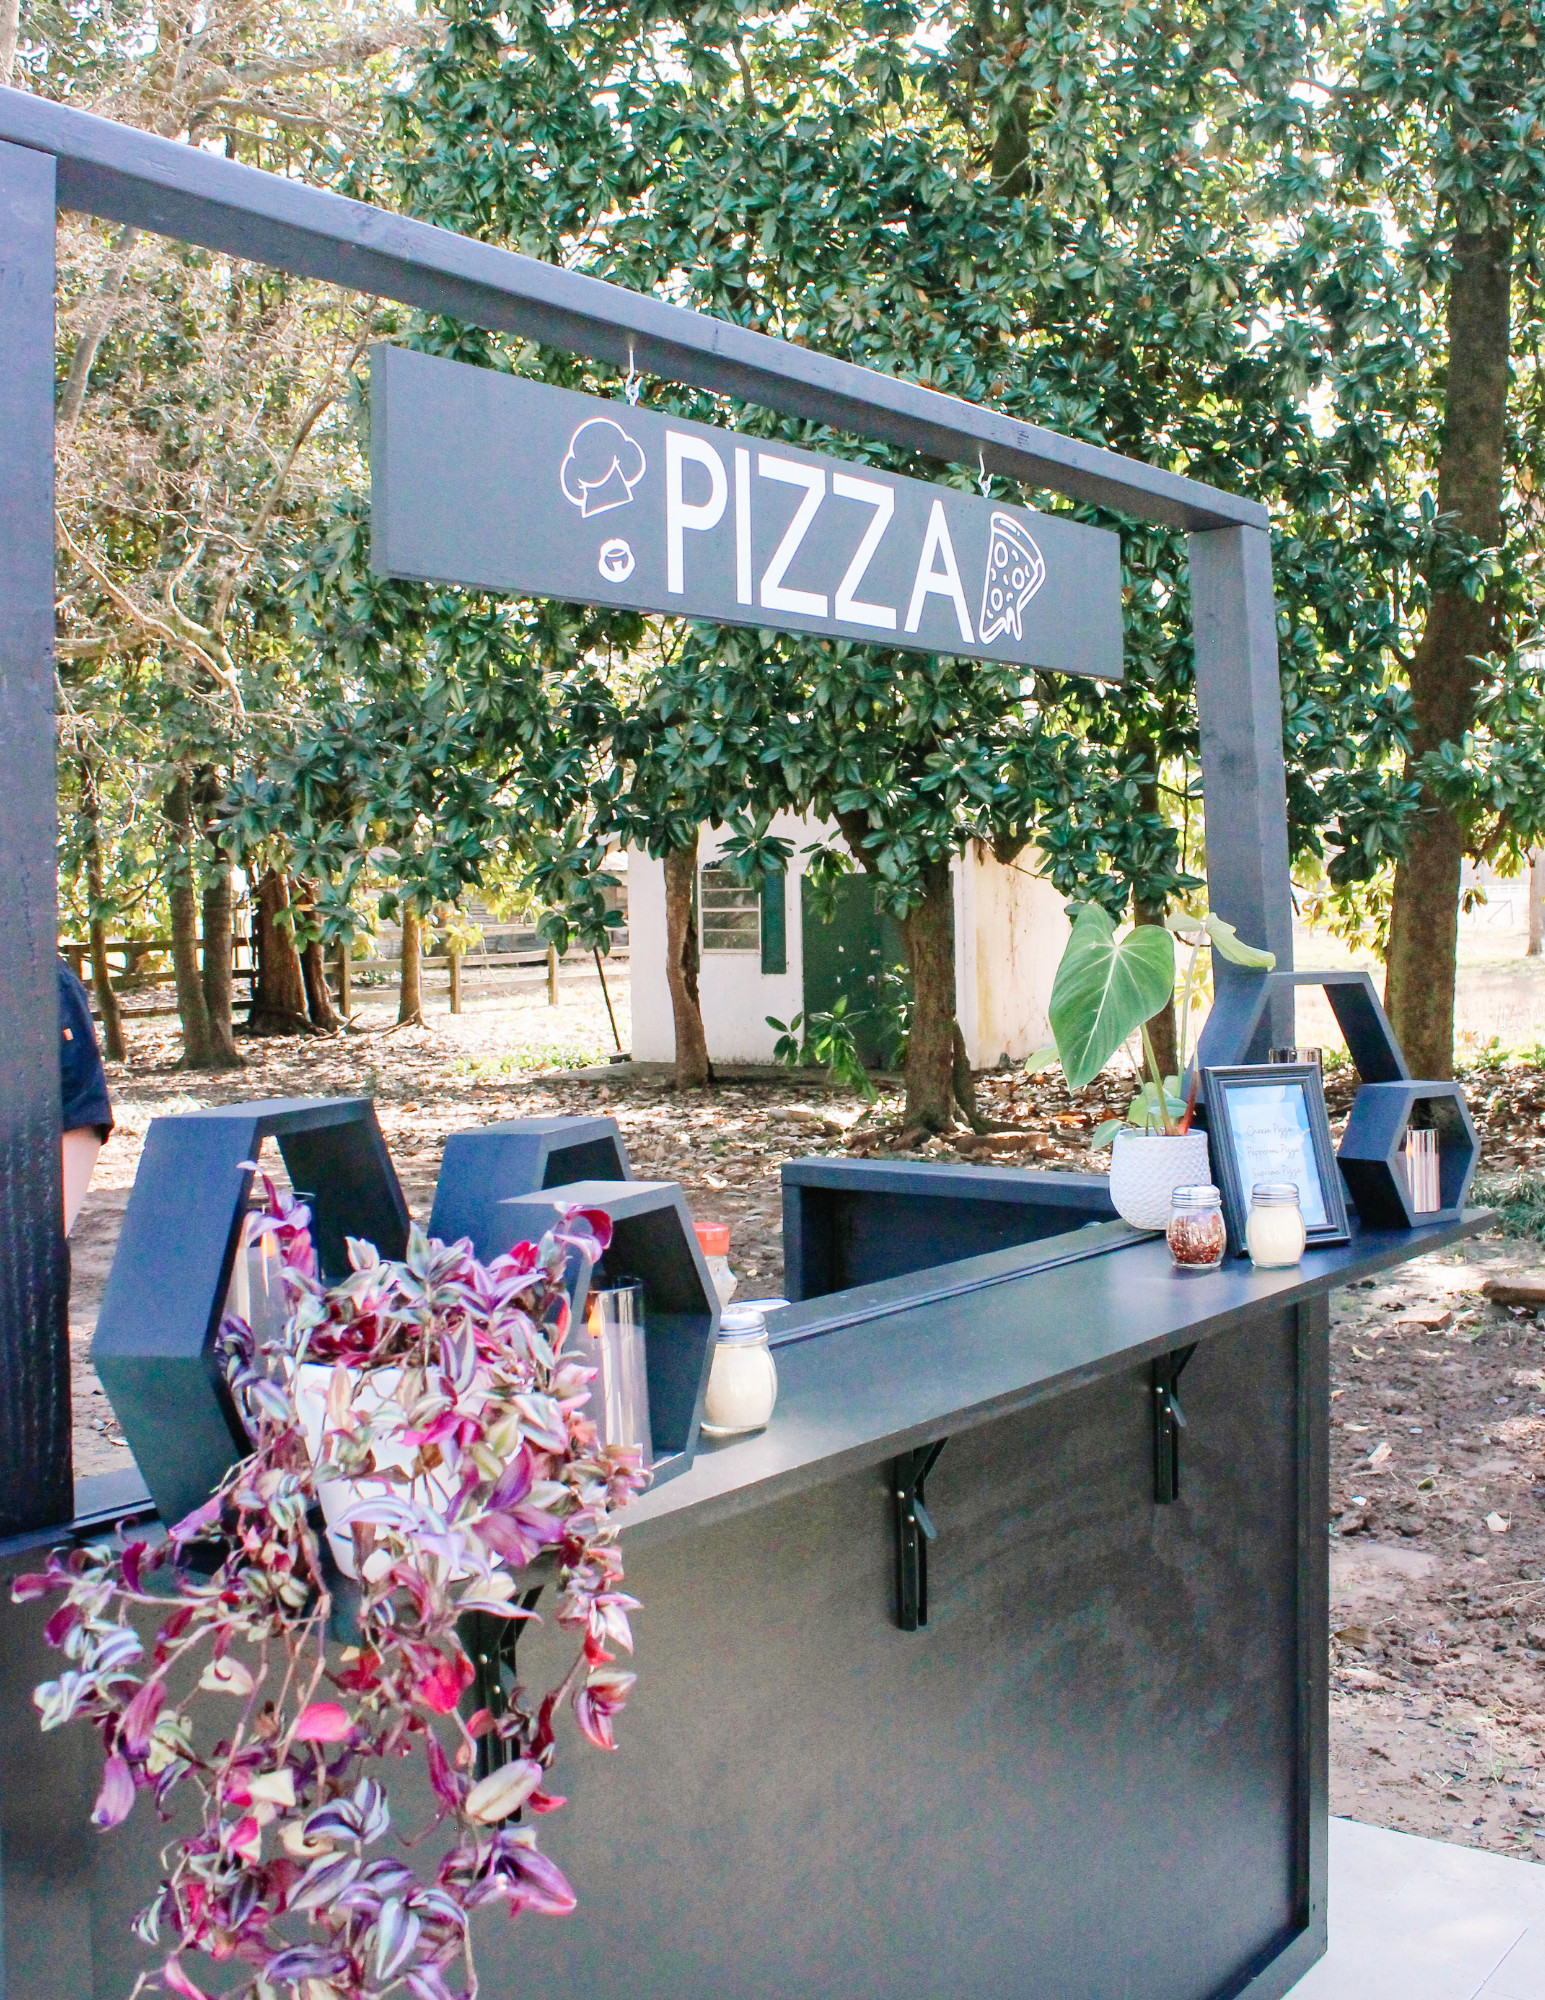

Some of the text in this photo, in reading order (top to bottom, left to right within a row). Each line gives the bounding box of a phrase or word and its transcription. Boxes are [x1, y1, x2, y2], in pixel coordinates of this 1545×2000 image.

[666, 430, 975, 643] PIZZA
[1246, 1123, 1292, 1139] Cheese Pizza
[1246, 1143, 1300, 1161] Pepperoni Pizza
[1251, 1164, 1302, 1181] Supreme Pizza
